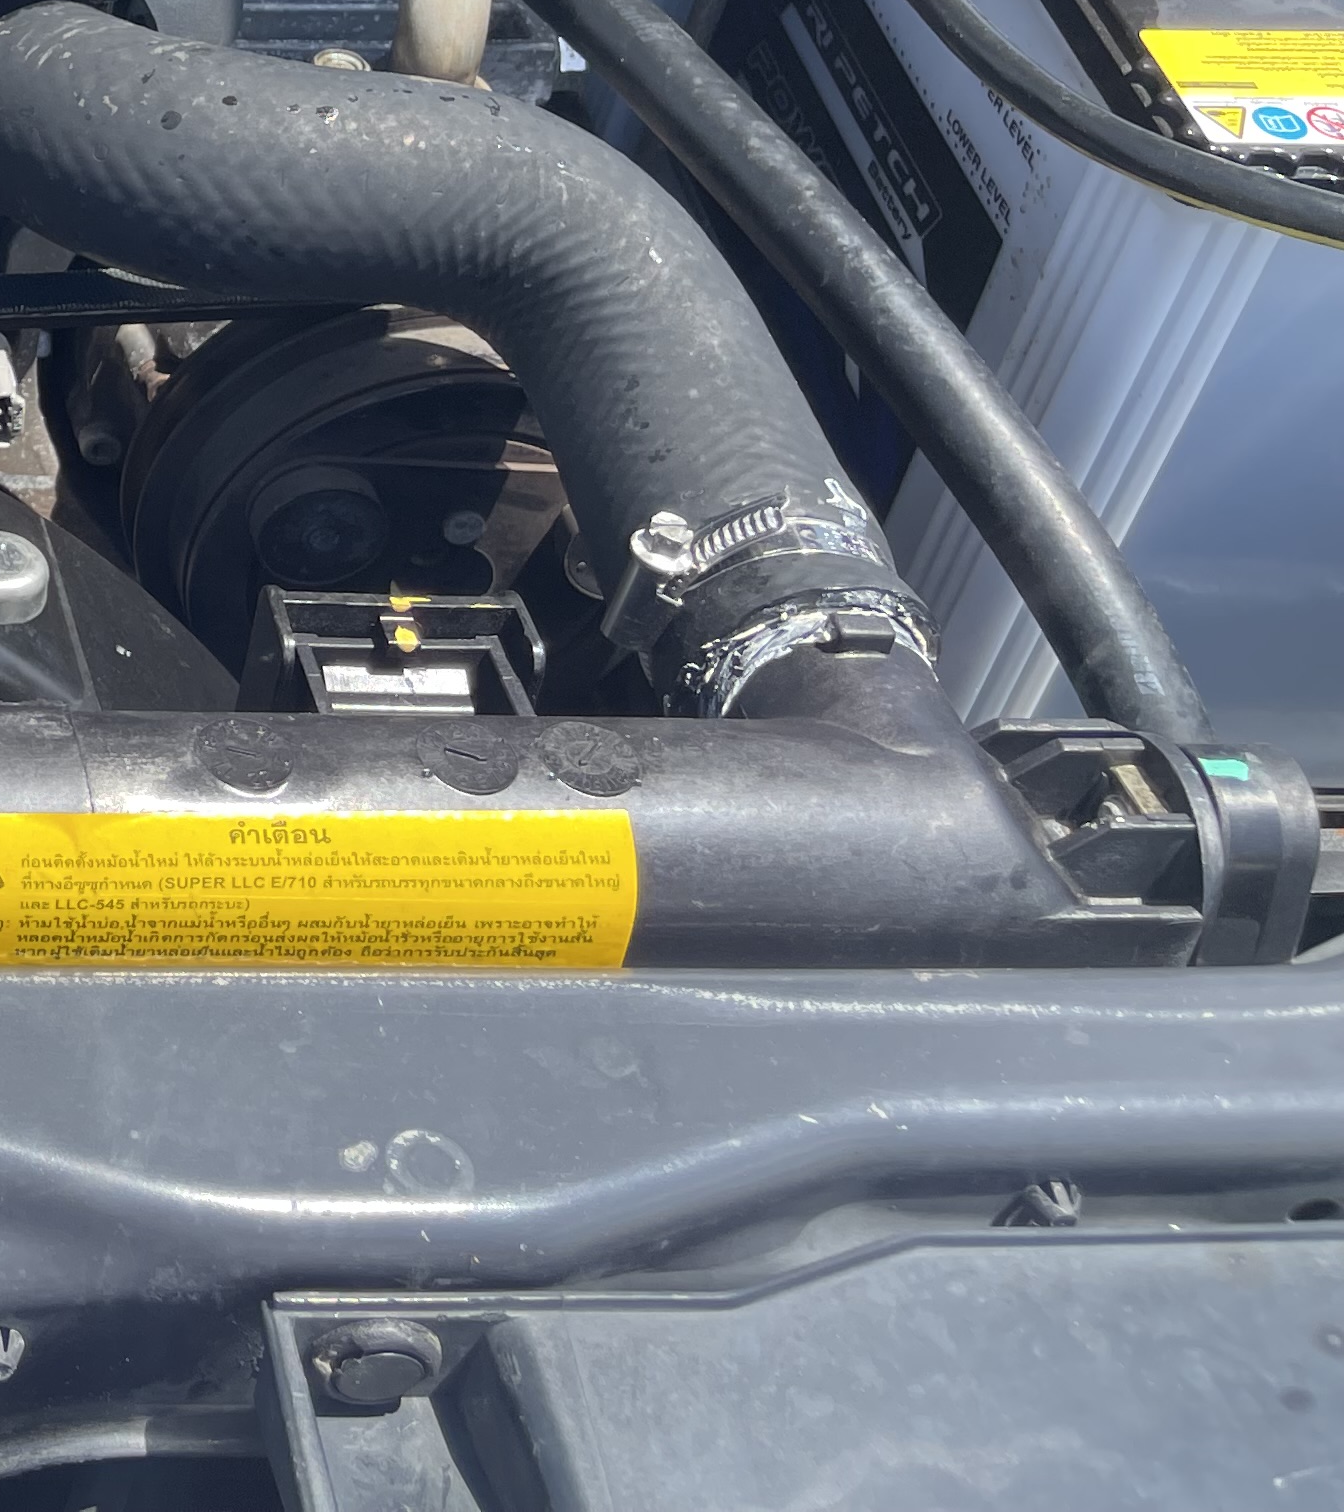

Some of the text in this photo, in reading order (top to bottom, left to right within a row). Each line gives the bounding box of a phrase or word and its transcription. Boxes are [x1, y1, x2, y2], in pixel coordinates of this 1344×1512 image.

[833, 54, 931, 223] PETCH
[946, 108, 1012, 228] LOWER LEVEL
[1001, 110, 1037, 172] LEVEL
[866, 159, 914, 241] Battery
[228, 820, 333, 845] คำเตือน
[19, 900, 50, 911] และ
[55, 898, 125, 911] LLC-545
[158, 876, 226, 892] (SUPER
[231, 876, 266, 890] LLC
[270, 875, 317, 890] E/710
